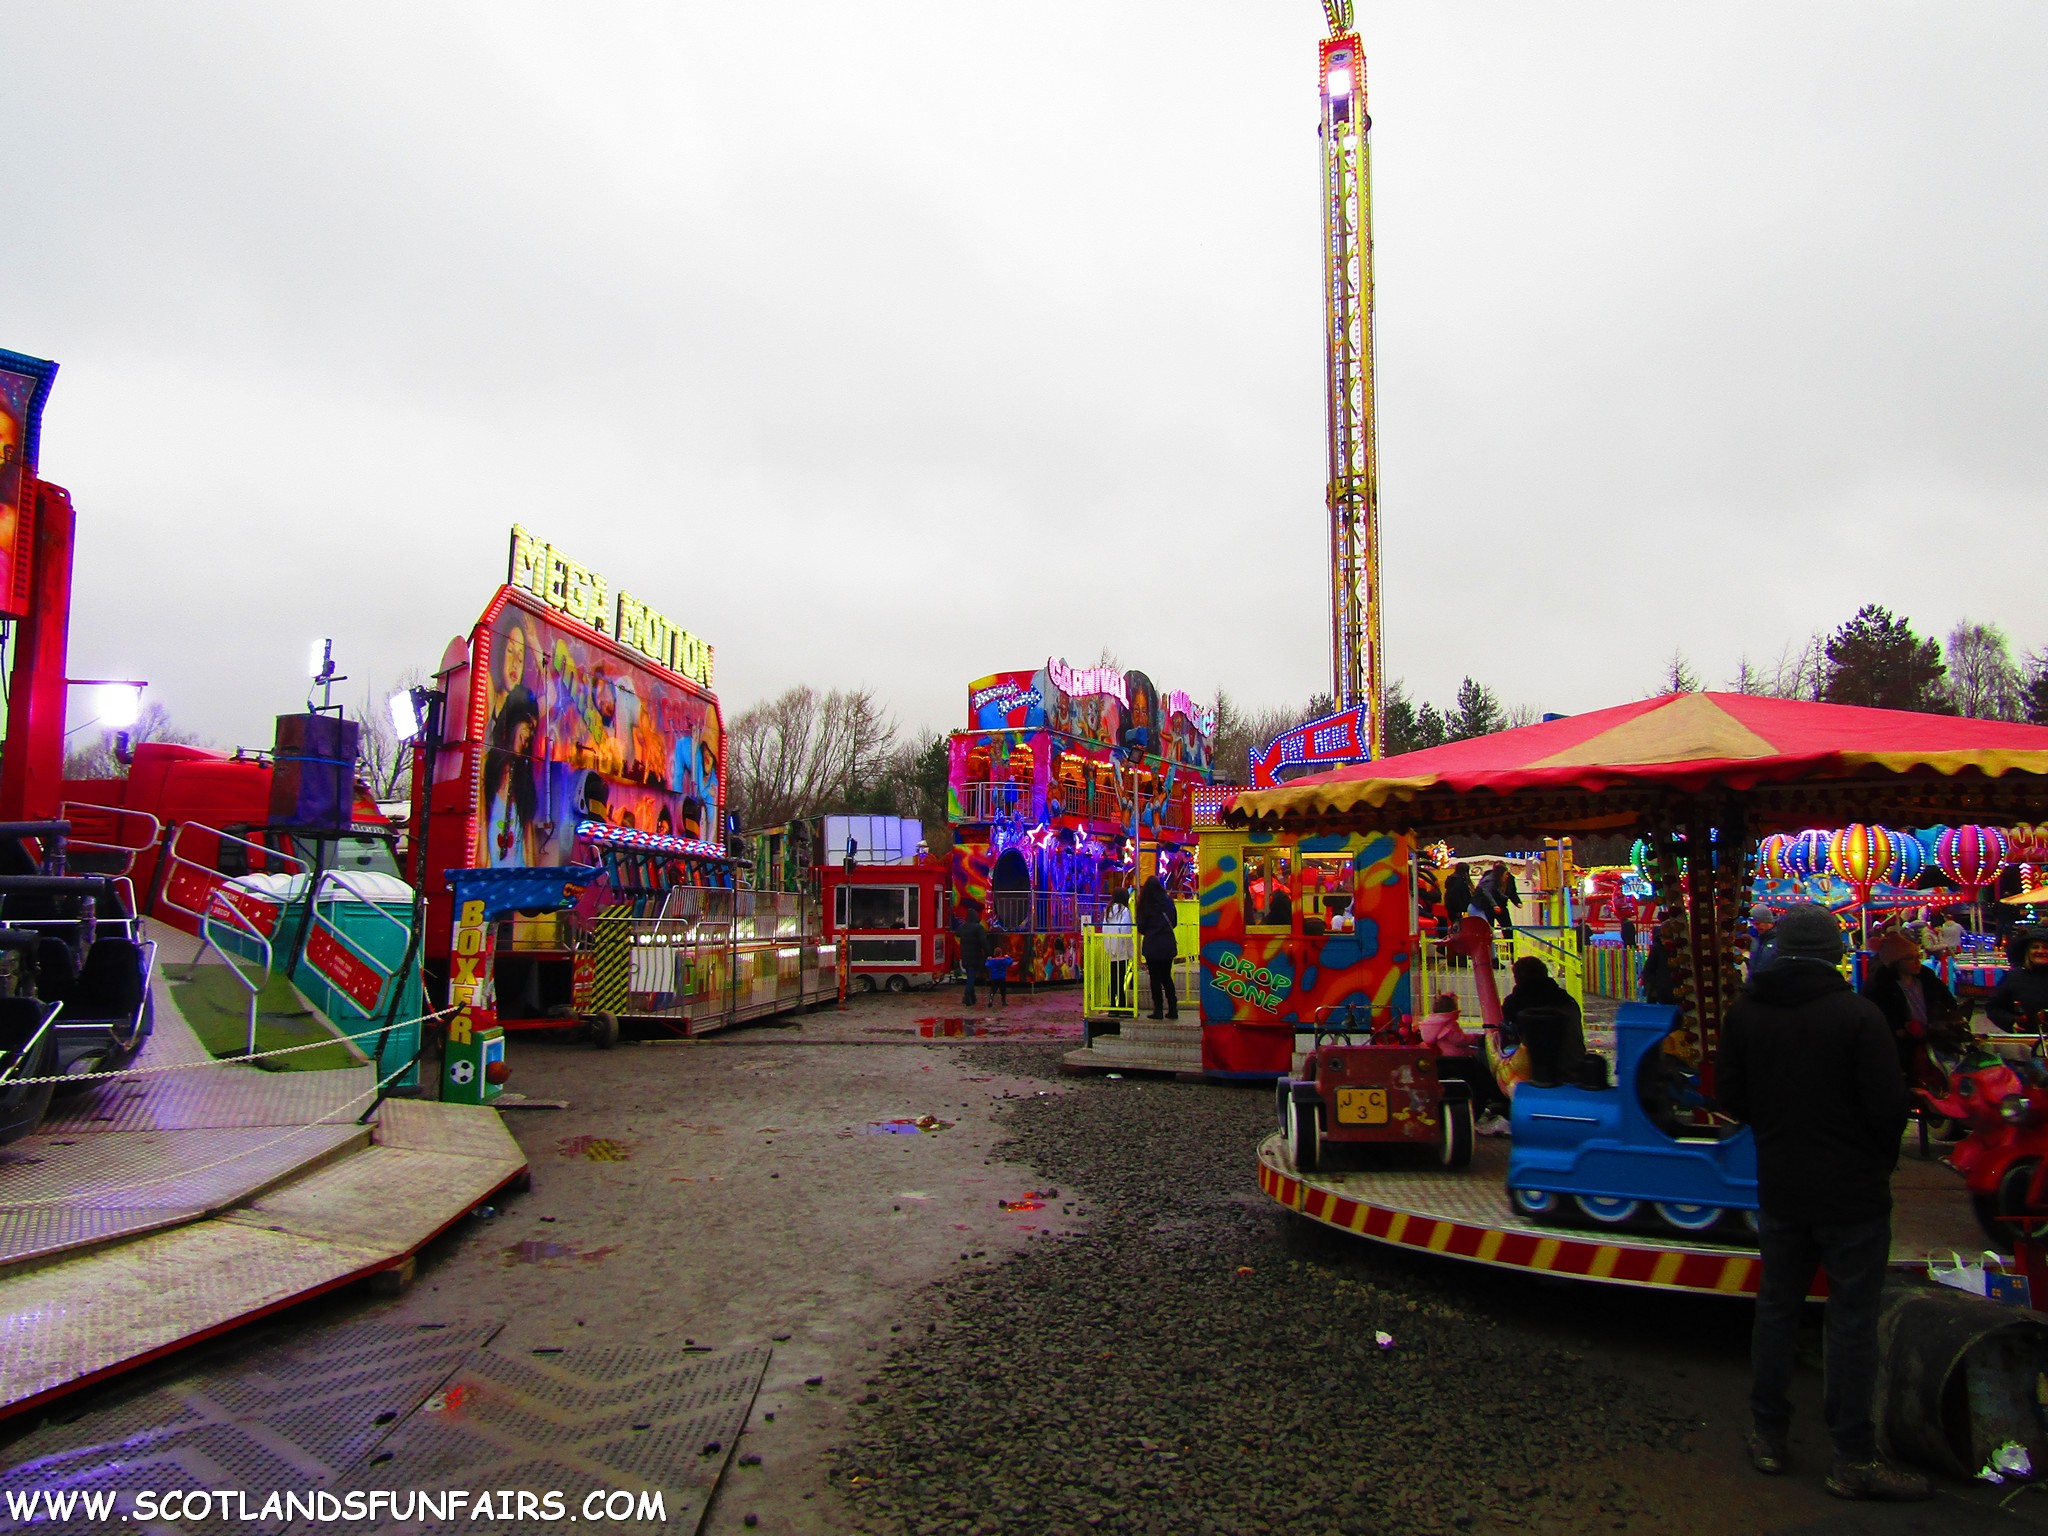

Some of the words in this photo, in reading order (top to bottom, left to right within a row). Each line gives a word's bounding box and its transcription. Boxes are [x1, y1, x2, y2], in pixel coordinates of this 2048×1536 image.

[511, 523, 611, 634] MEGA
[617, 589, 715, 689] MOTION
[1047, 656, 1130, 711] CARNIVAL
[1280, 733, 1305, 761] PAY
[1313, 722, 1351, 755] HERE
[450, 900, 486, 1045] BOXER
[1209, 970, 1283, 1015] ZONE
[1219, 951, 1292, 992] DROP
[1343, 1092, 1352, 1106] J
[1369, 1092, 1381, 1106] C
[1357, 1105, 1368, 1120] 3
